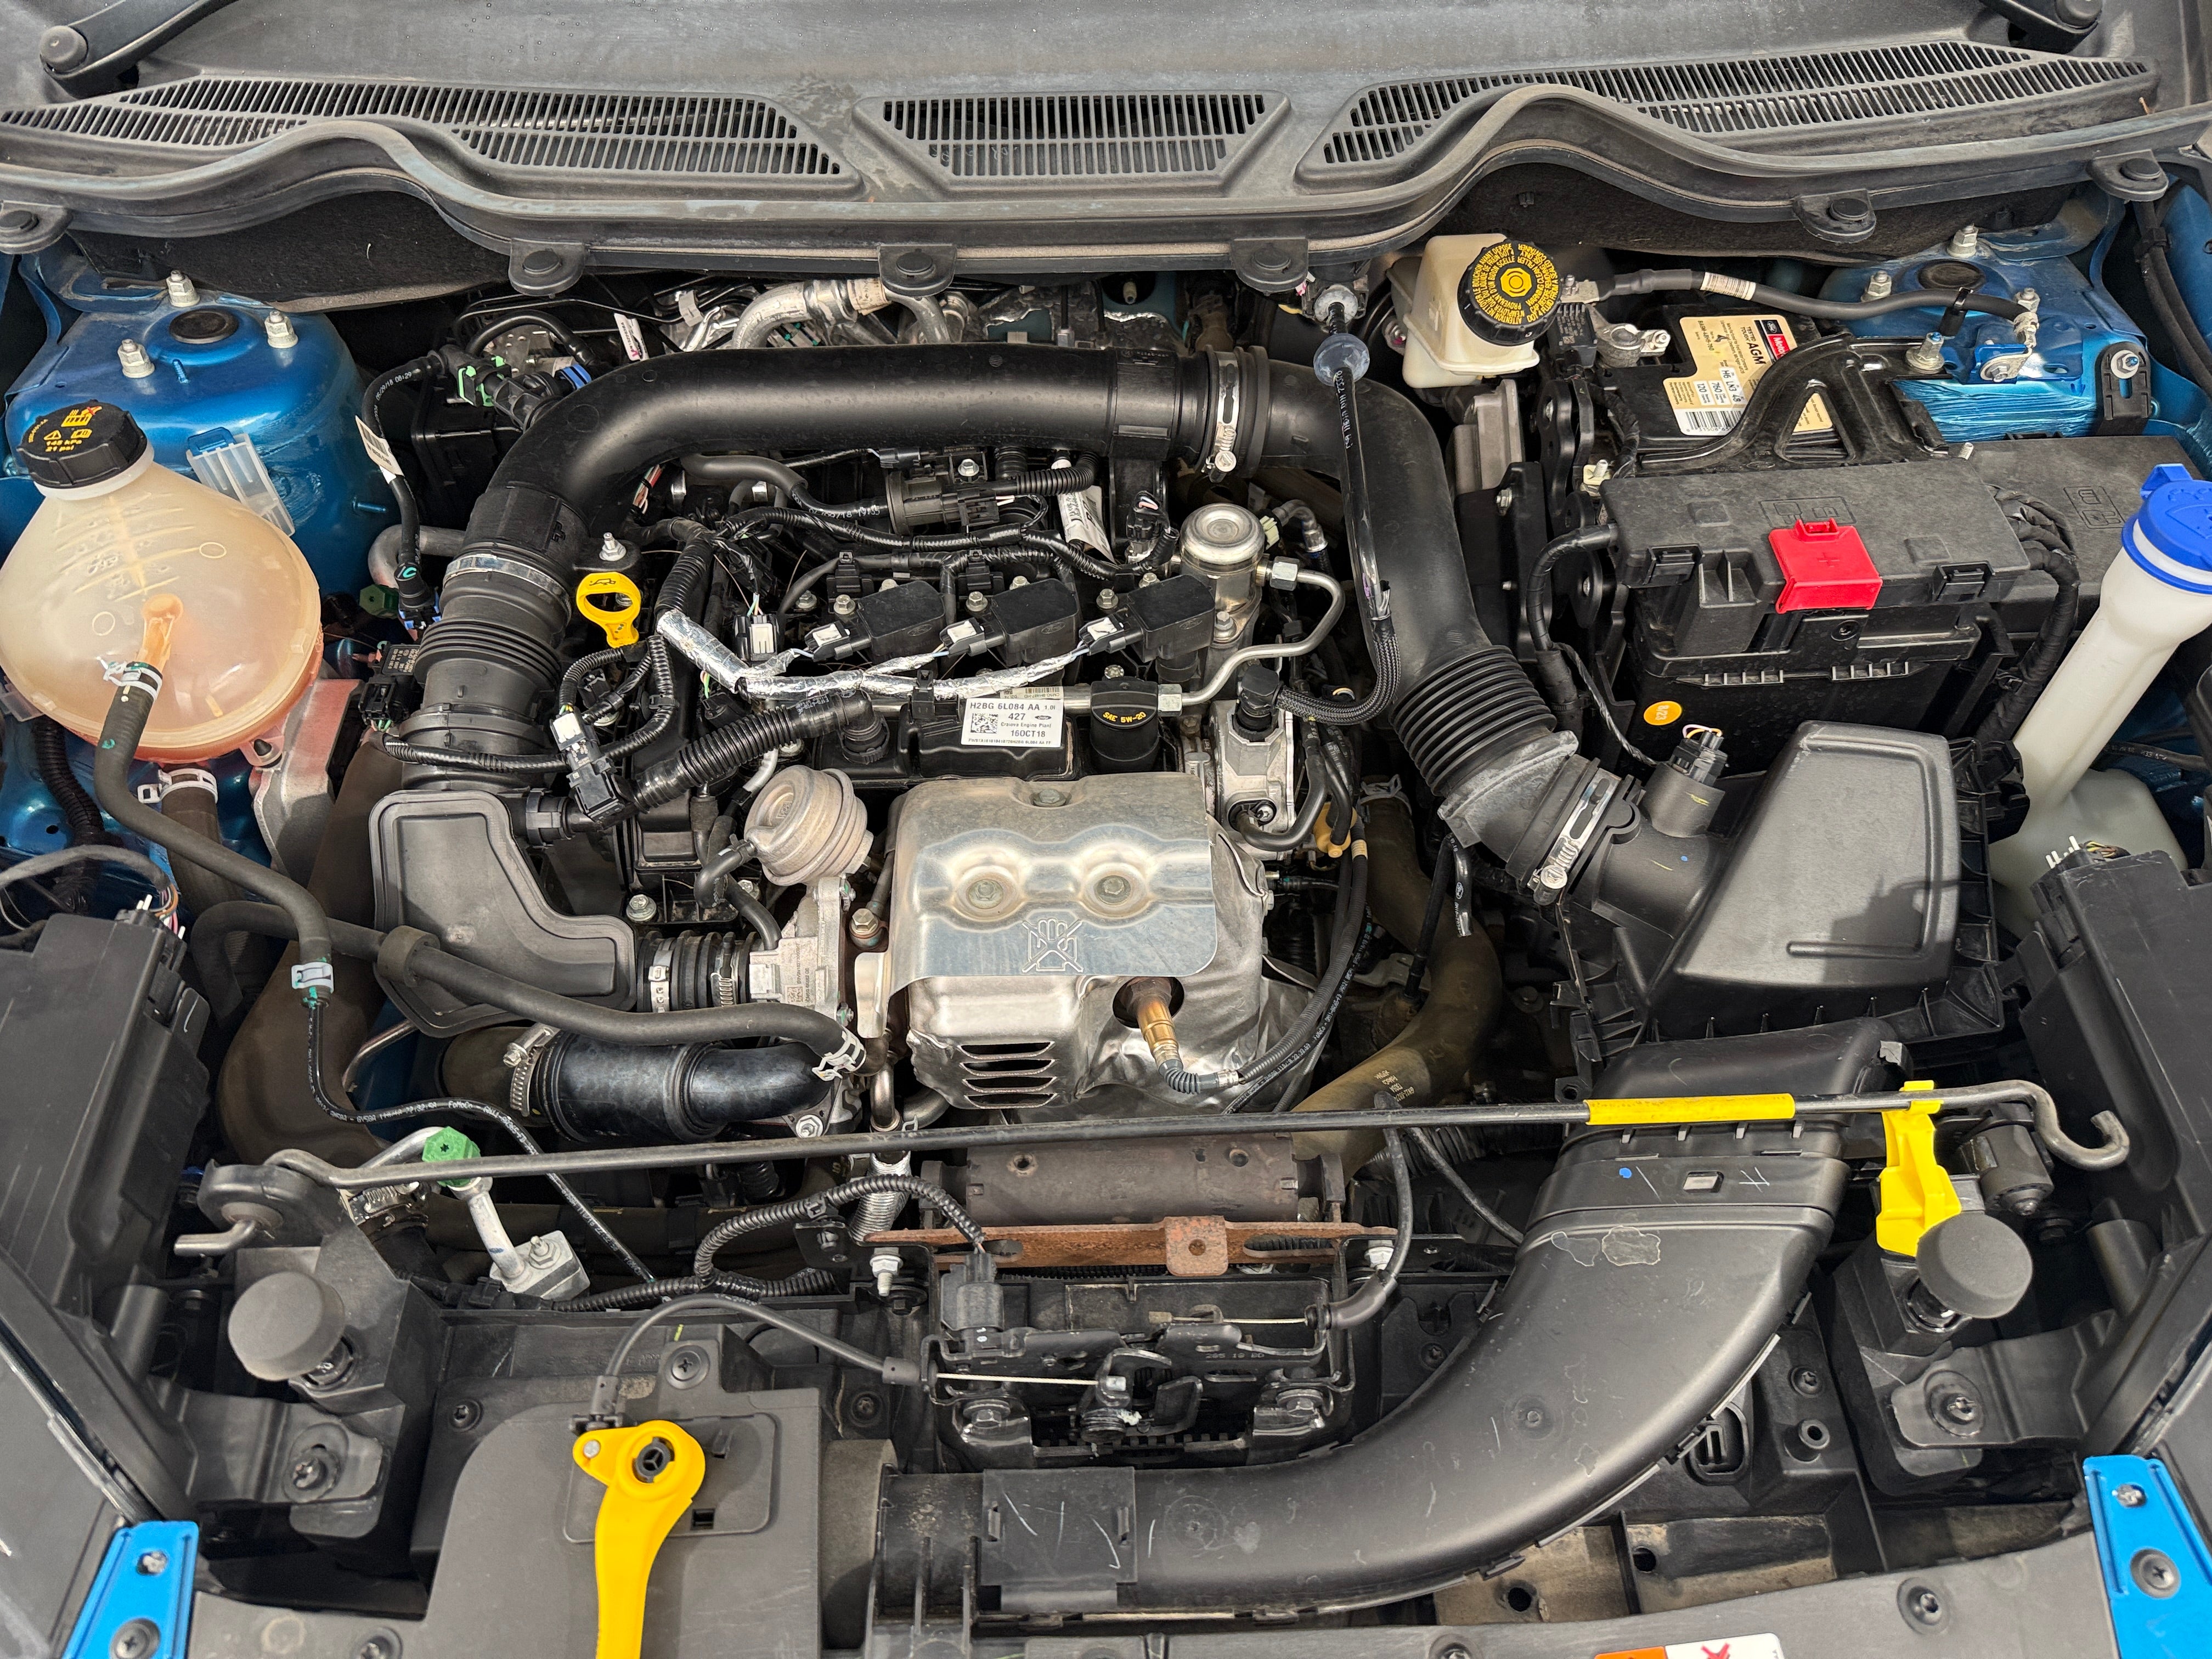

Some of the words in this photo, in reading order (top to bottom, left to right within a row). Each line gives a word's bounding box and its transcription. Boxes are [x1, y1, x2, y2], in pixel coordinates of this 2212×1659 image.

[1474, 294, 1496, 317] NETTOYER
[1491, 292, 1522, 310] PROVENANT
[1493, 312, 1522, 324] ATTENTION
[1746, 326, 1756, 342] TESTED
[1746, 341, 1767, 365] AGM
[1722, 369, 1733, 379] H6
[1697, 383, 1707, 392] 120
[1712, 382, 1722, 393] 760
[1726, 381, 1737, 392] LN3
[1731, 394, 1741, 402] 48
[1102, 711, 1117, 723] SAE
[1120, 711, 1147, 724] 5W-20
[1654, 704, 1670, 721] 8/23
